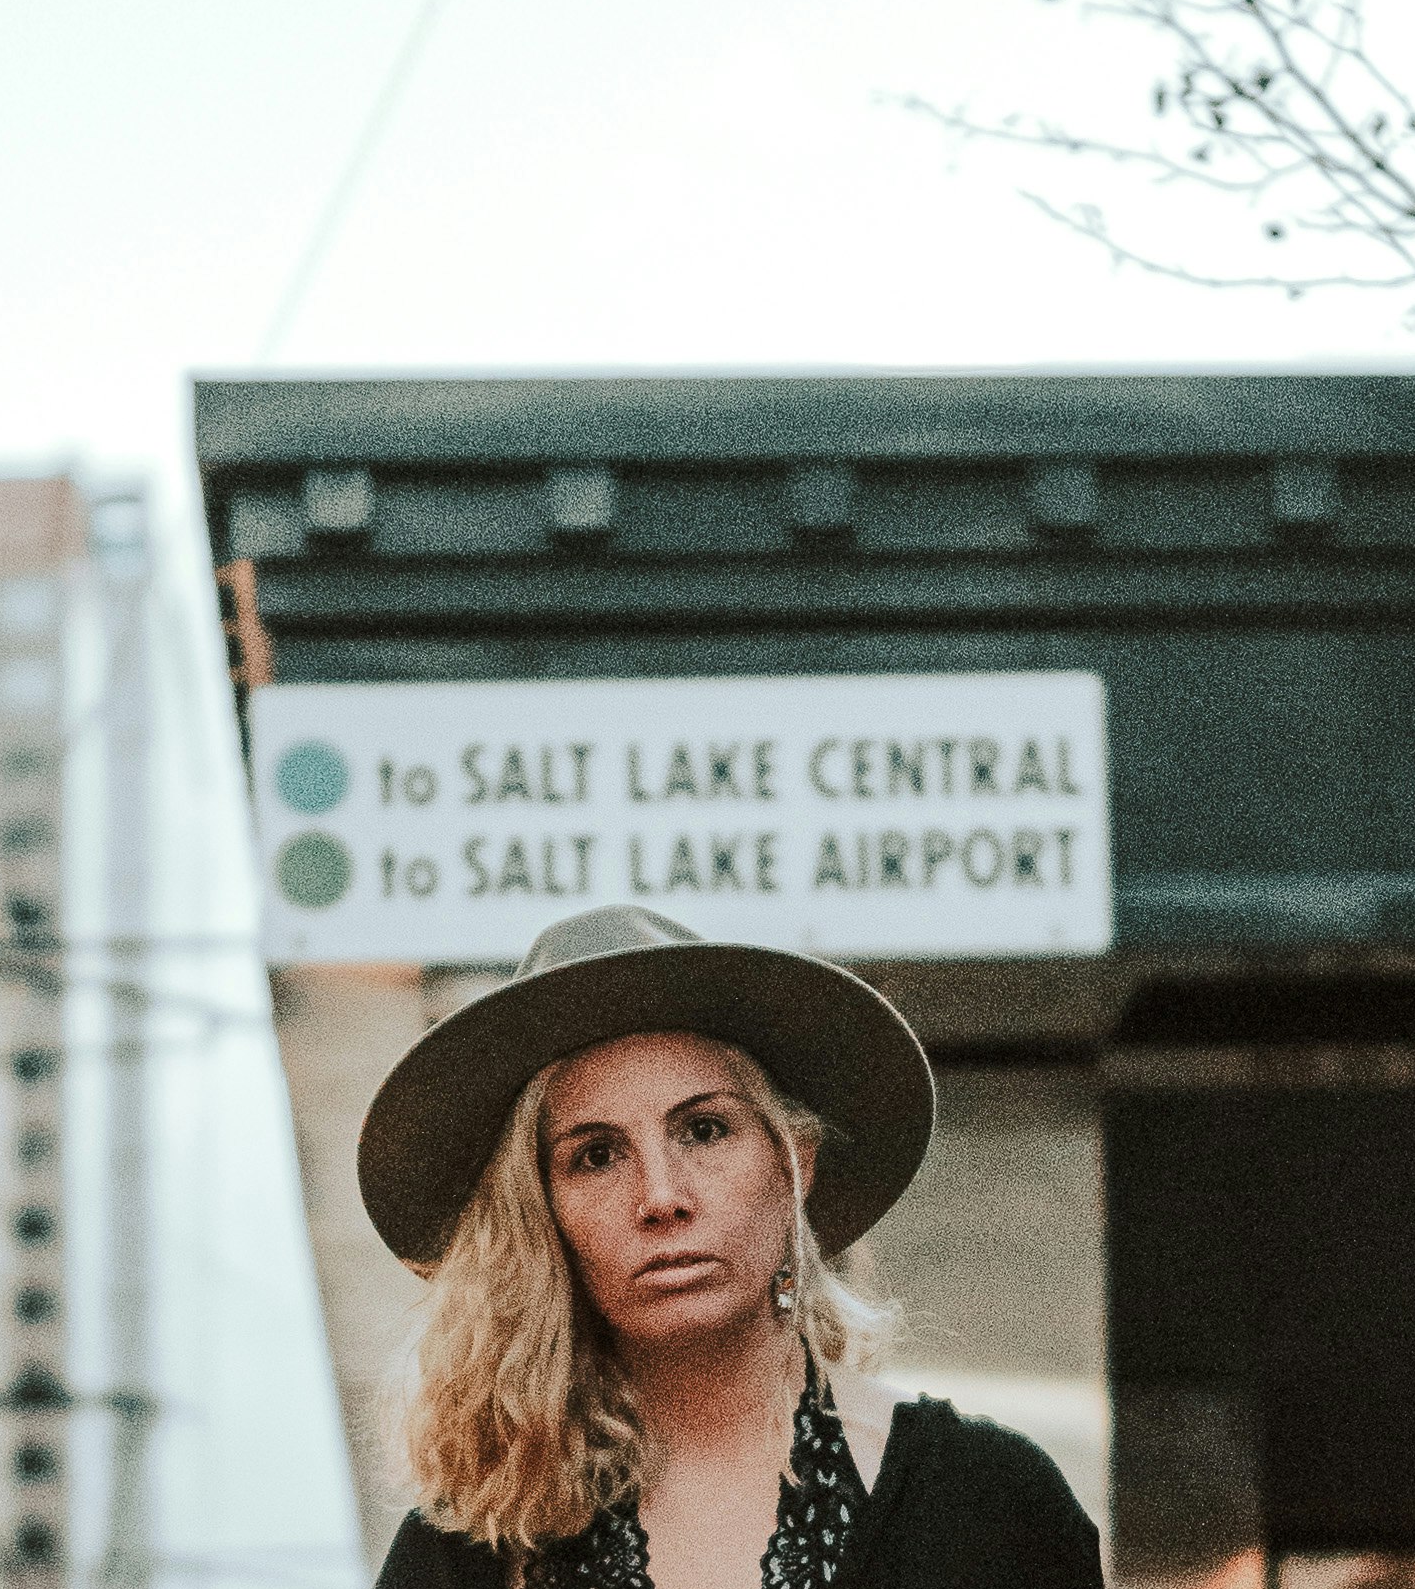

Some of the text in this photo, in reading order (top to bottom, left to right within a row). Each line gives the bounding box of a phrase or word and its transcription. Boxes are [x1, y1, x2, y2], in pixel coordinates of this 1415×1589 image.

[377, 737, 1079, 807] to SALT LAKE CENTRAL
[379, 828, 1075, 898] to SALT LAKE AIRPORT
